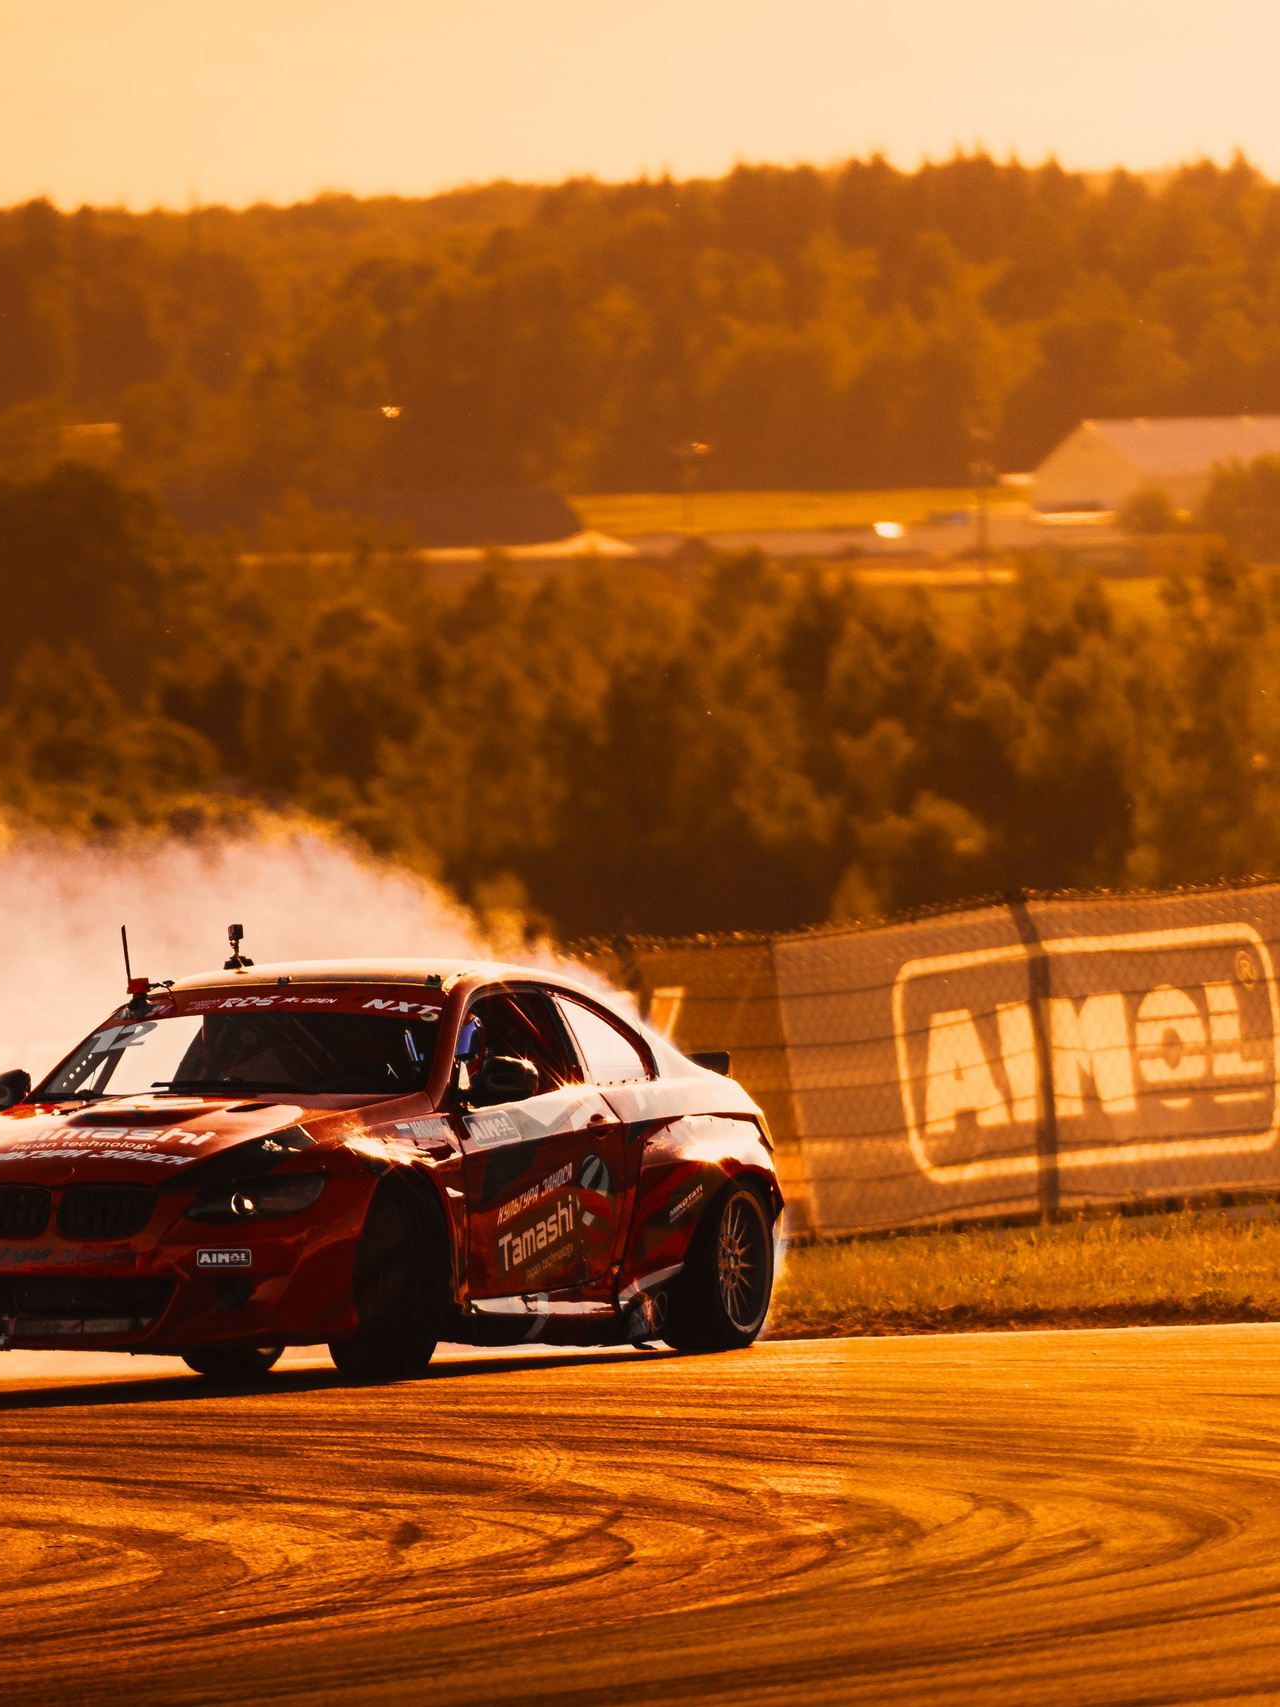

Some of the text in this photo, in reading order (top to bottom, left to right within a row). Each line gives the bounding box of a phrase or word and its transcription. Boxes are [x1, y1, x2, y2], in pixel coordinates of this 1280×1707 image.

[219, 995, 281, 1009] RDS
[361, 998, 443, 1015] NXT
[90, 1021, 158, 1054] 12
[924, 980, 1265, 1134] AIMOL
[20, 1127, 216, 1146] amashi
[62, 1140, 158, 1151] technology
[497, 1162, 573, 1226] КУЛЬТУРА ЗАНОСА
[499, 1194, 574, 1271] Tamashi
[200, 1253, 249, 1263] AIMOL
